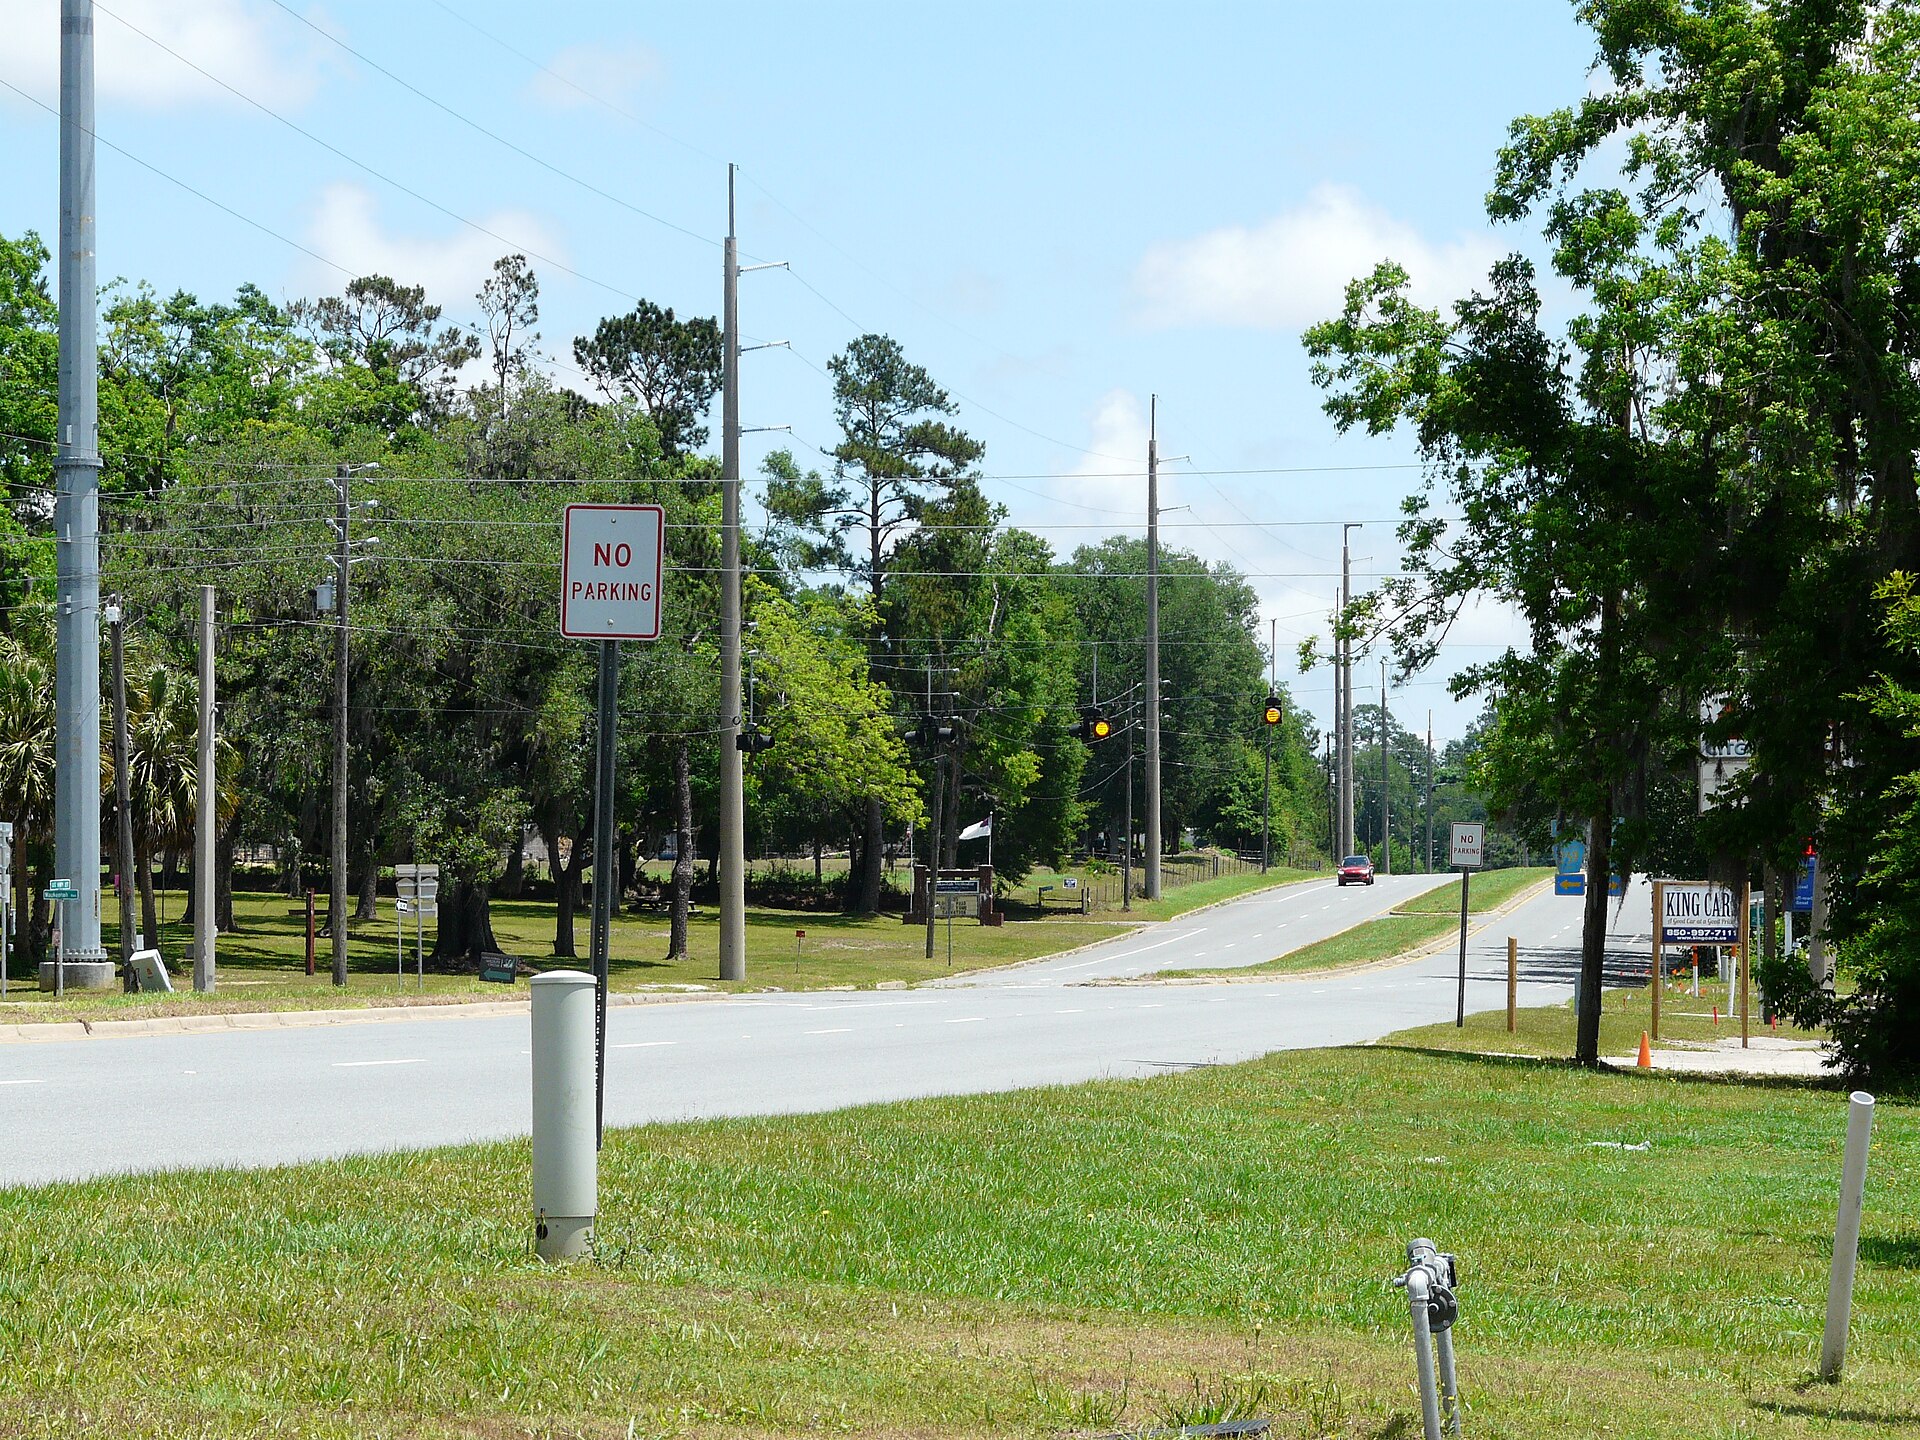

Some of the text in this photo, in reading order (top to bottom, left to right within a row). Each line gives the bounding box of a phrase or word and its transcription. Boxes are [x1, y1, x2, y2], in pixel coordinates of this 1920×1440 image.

[593, 542, 632, 567] NO
[571, 581, 652, 602] PARKING
[1460, 835, 1474, 844] NO
[1453, 847, 1480, 855] PARKING
[1666, 892, 1700, 917] KING
[1673, 918, 1687, 926] Good
[1707, 918, 1721, 926] Good
